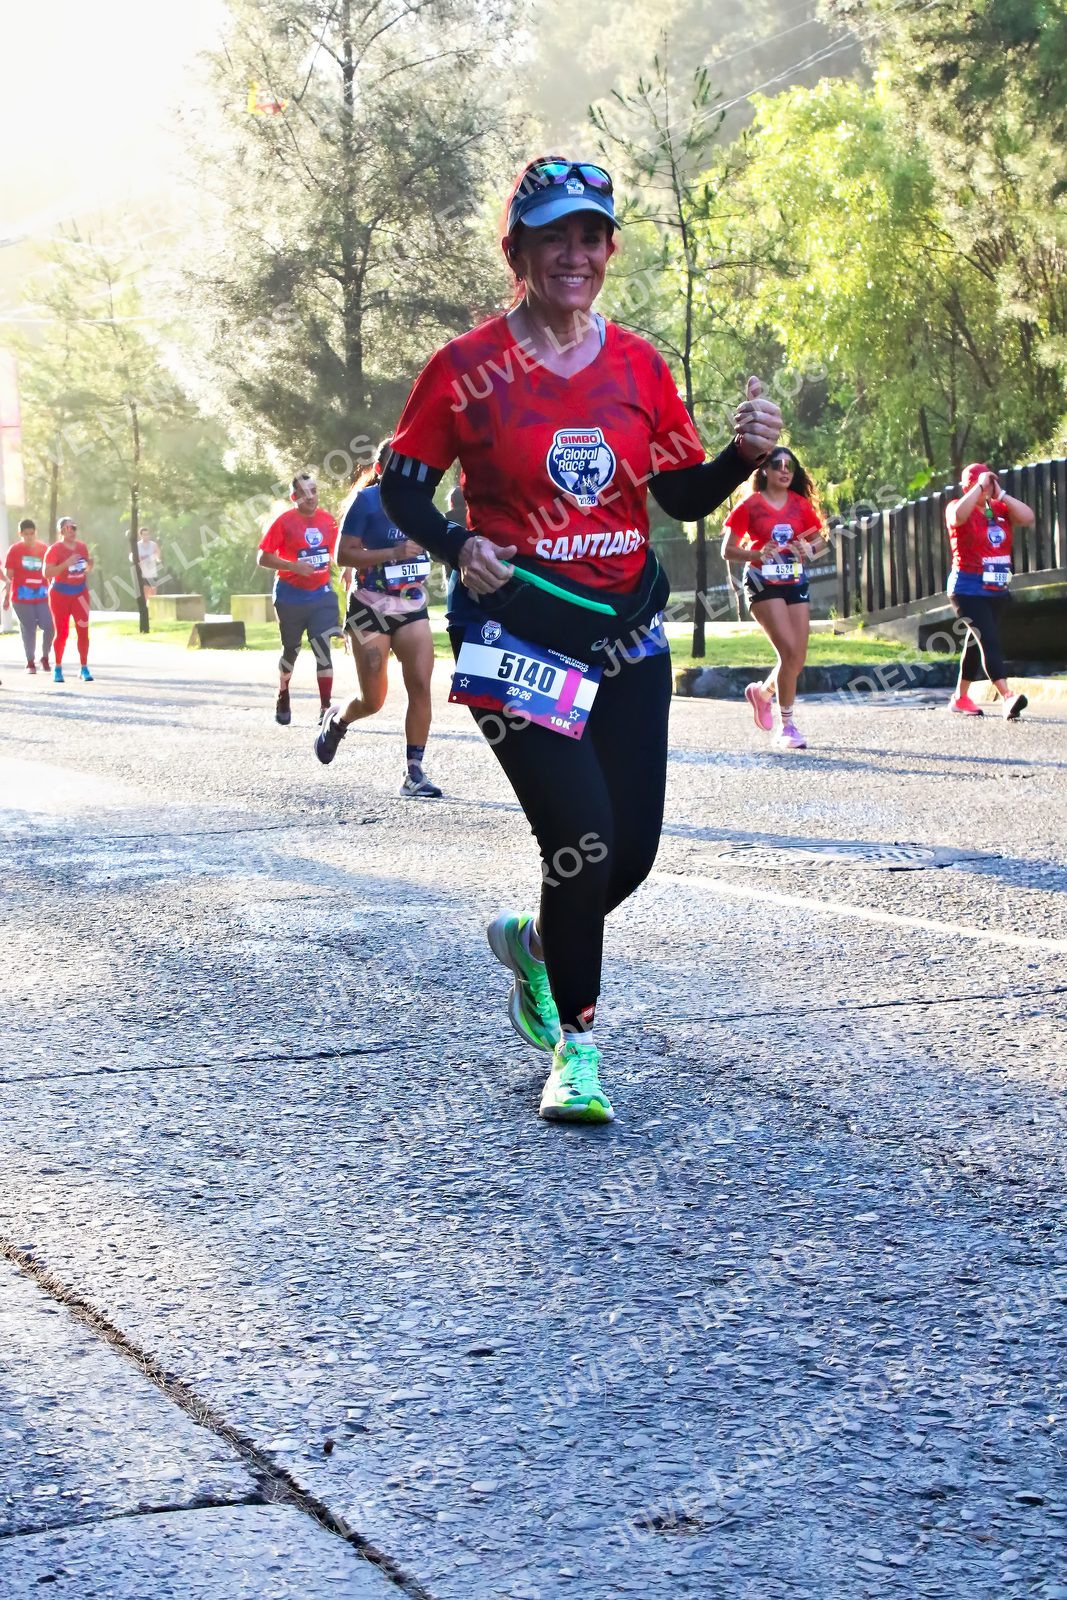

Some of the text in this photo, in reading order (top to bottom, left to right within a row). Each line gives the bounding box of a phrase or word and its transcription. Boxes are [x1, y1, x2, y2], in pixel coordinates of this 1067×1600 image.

[560, 435, 597, 444] BIMBO
[563, 447, 598, 461] Global
[557, 460, 585, 473] Race
[401, 564, 419, 576] 5741
[775, 564, 794, 574] 4524
[497, 652, 557, 693] 5140
[550, 716, 572, 730] 10K
